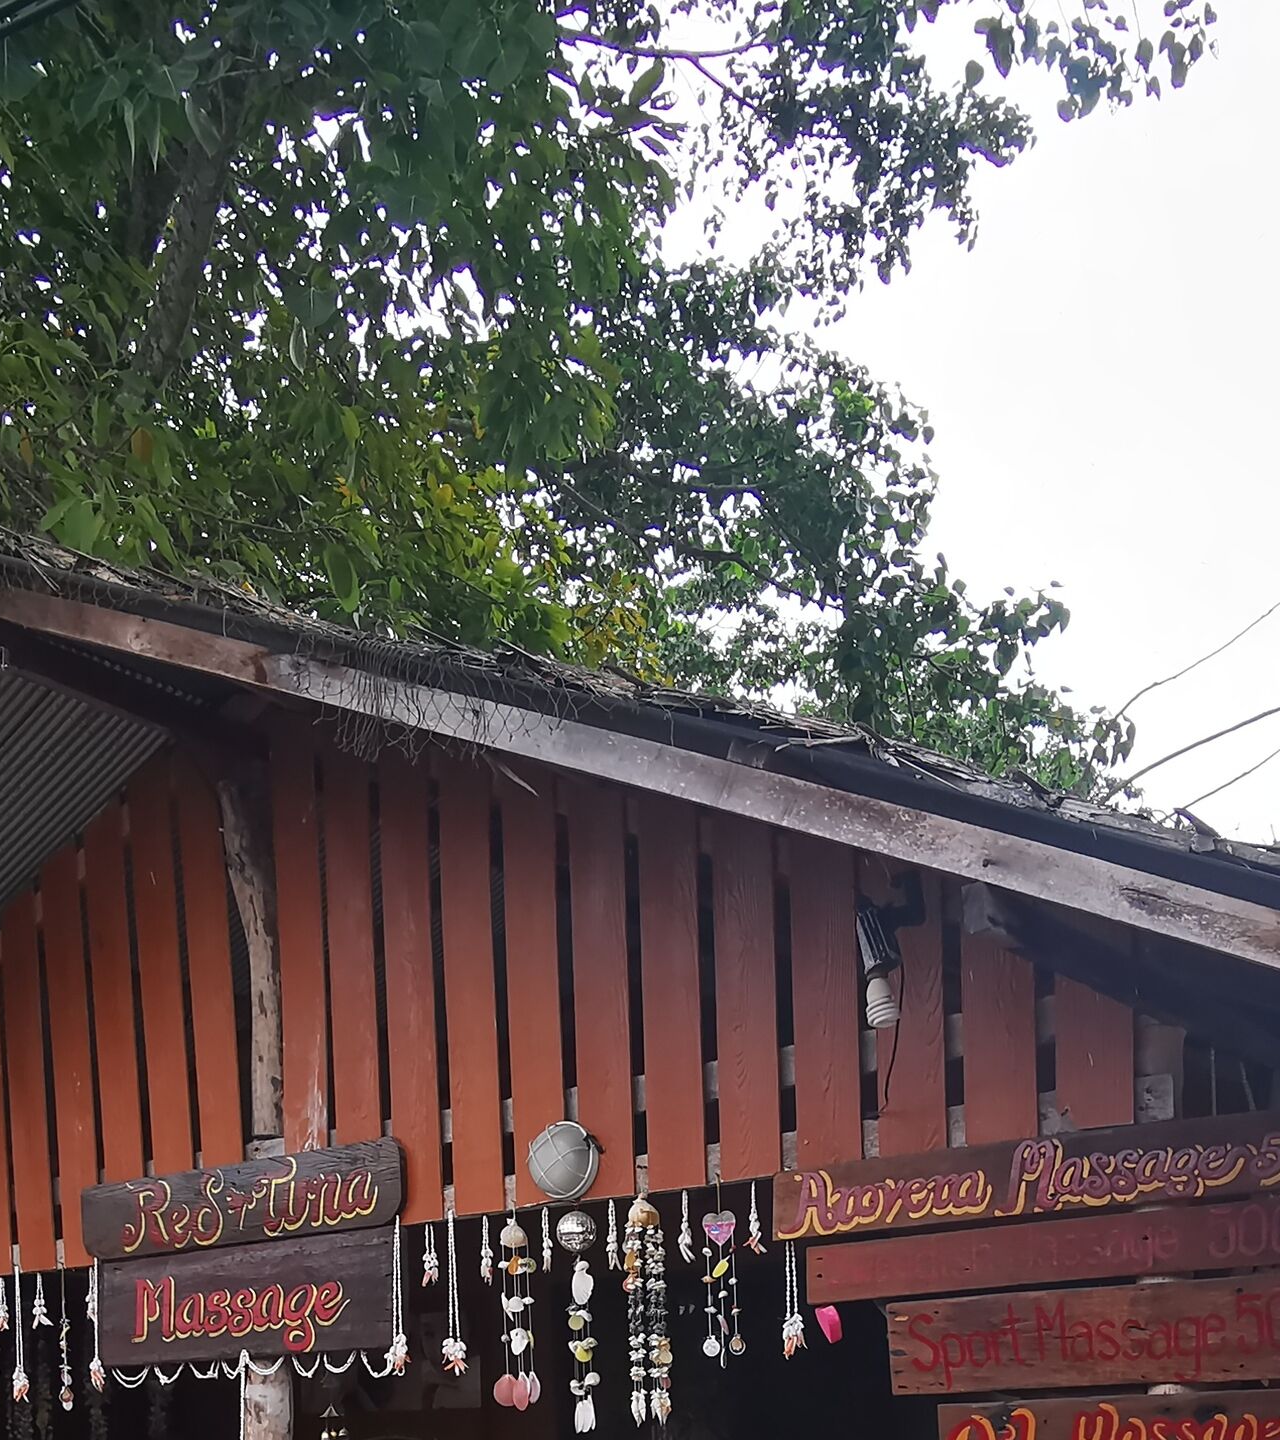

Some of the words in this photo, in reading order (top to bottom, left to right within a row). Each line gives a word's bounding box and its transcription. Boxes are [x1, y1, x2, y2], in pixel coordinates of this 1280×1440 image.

[253, 1156, 378, 1236] Tuna
[993, 1138, 1242, 1217] Massage
[132, 1276, 351, 1352] Massage
[909, 1304, 1021, 1391] Sport
[1034, 1304, 1226, 1380] Massage
